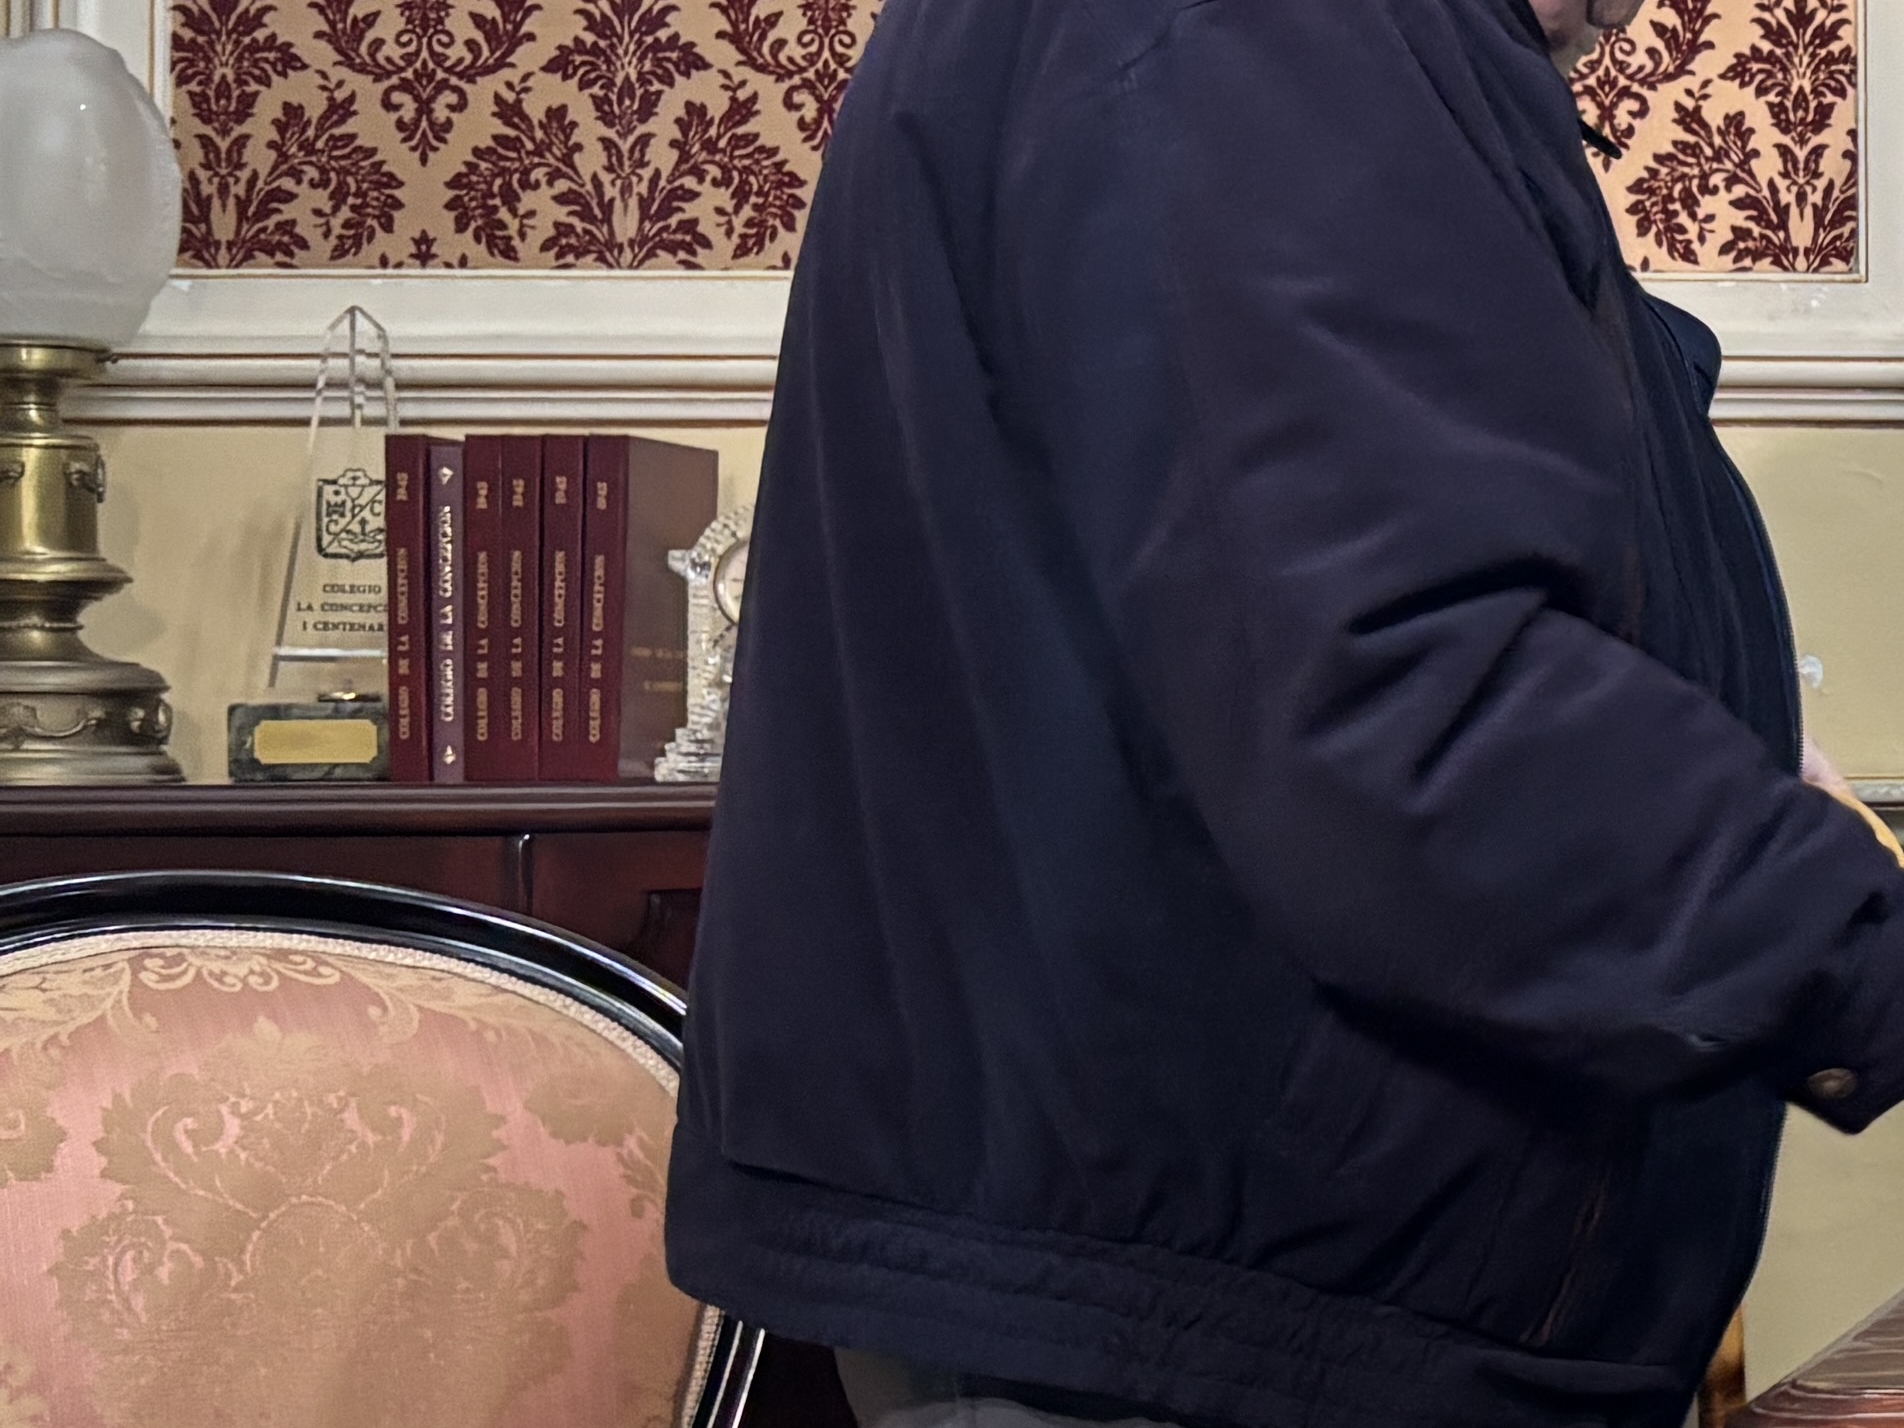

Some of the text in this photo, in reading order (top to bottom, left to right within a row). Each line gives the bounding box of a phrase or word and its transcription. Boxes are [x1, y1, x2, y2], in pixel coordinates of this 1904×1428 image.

[322, 583, 382, 594] COLEGIO
[296, 601, 314, 612] LA
[440, 605, 453, 624] LA
[440, 630, 453, 651] DE
[440, 658, 454, 722] COLEGIO
